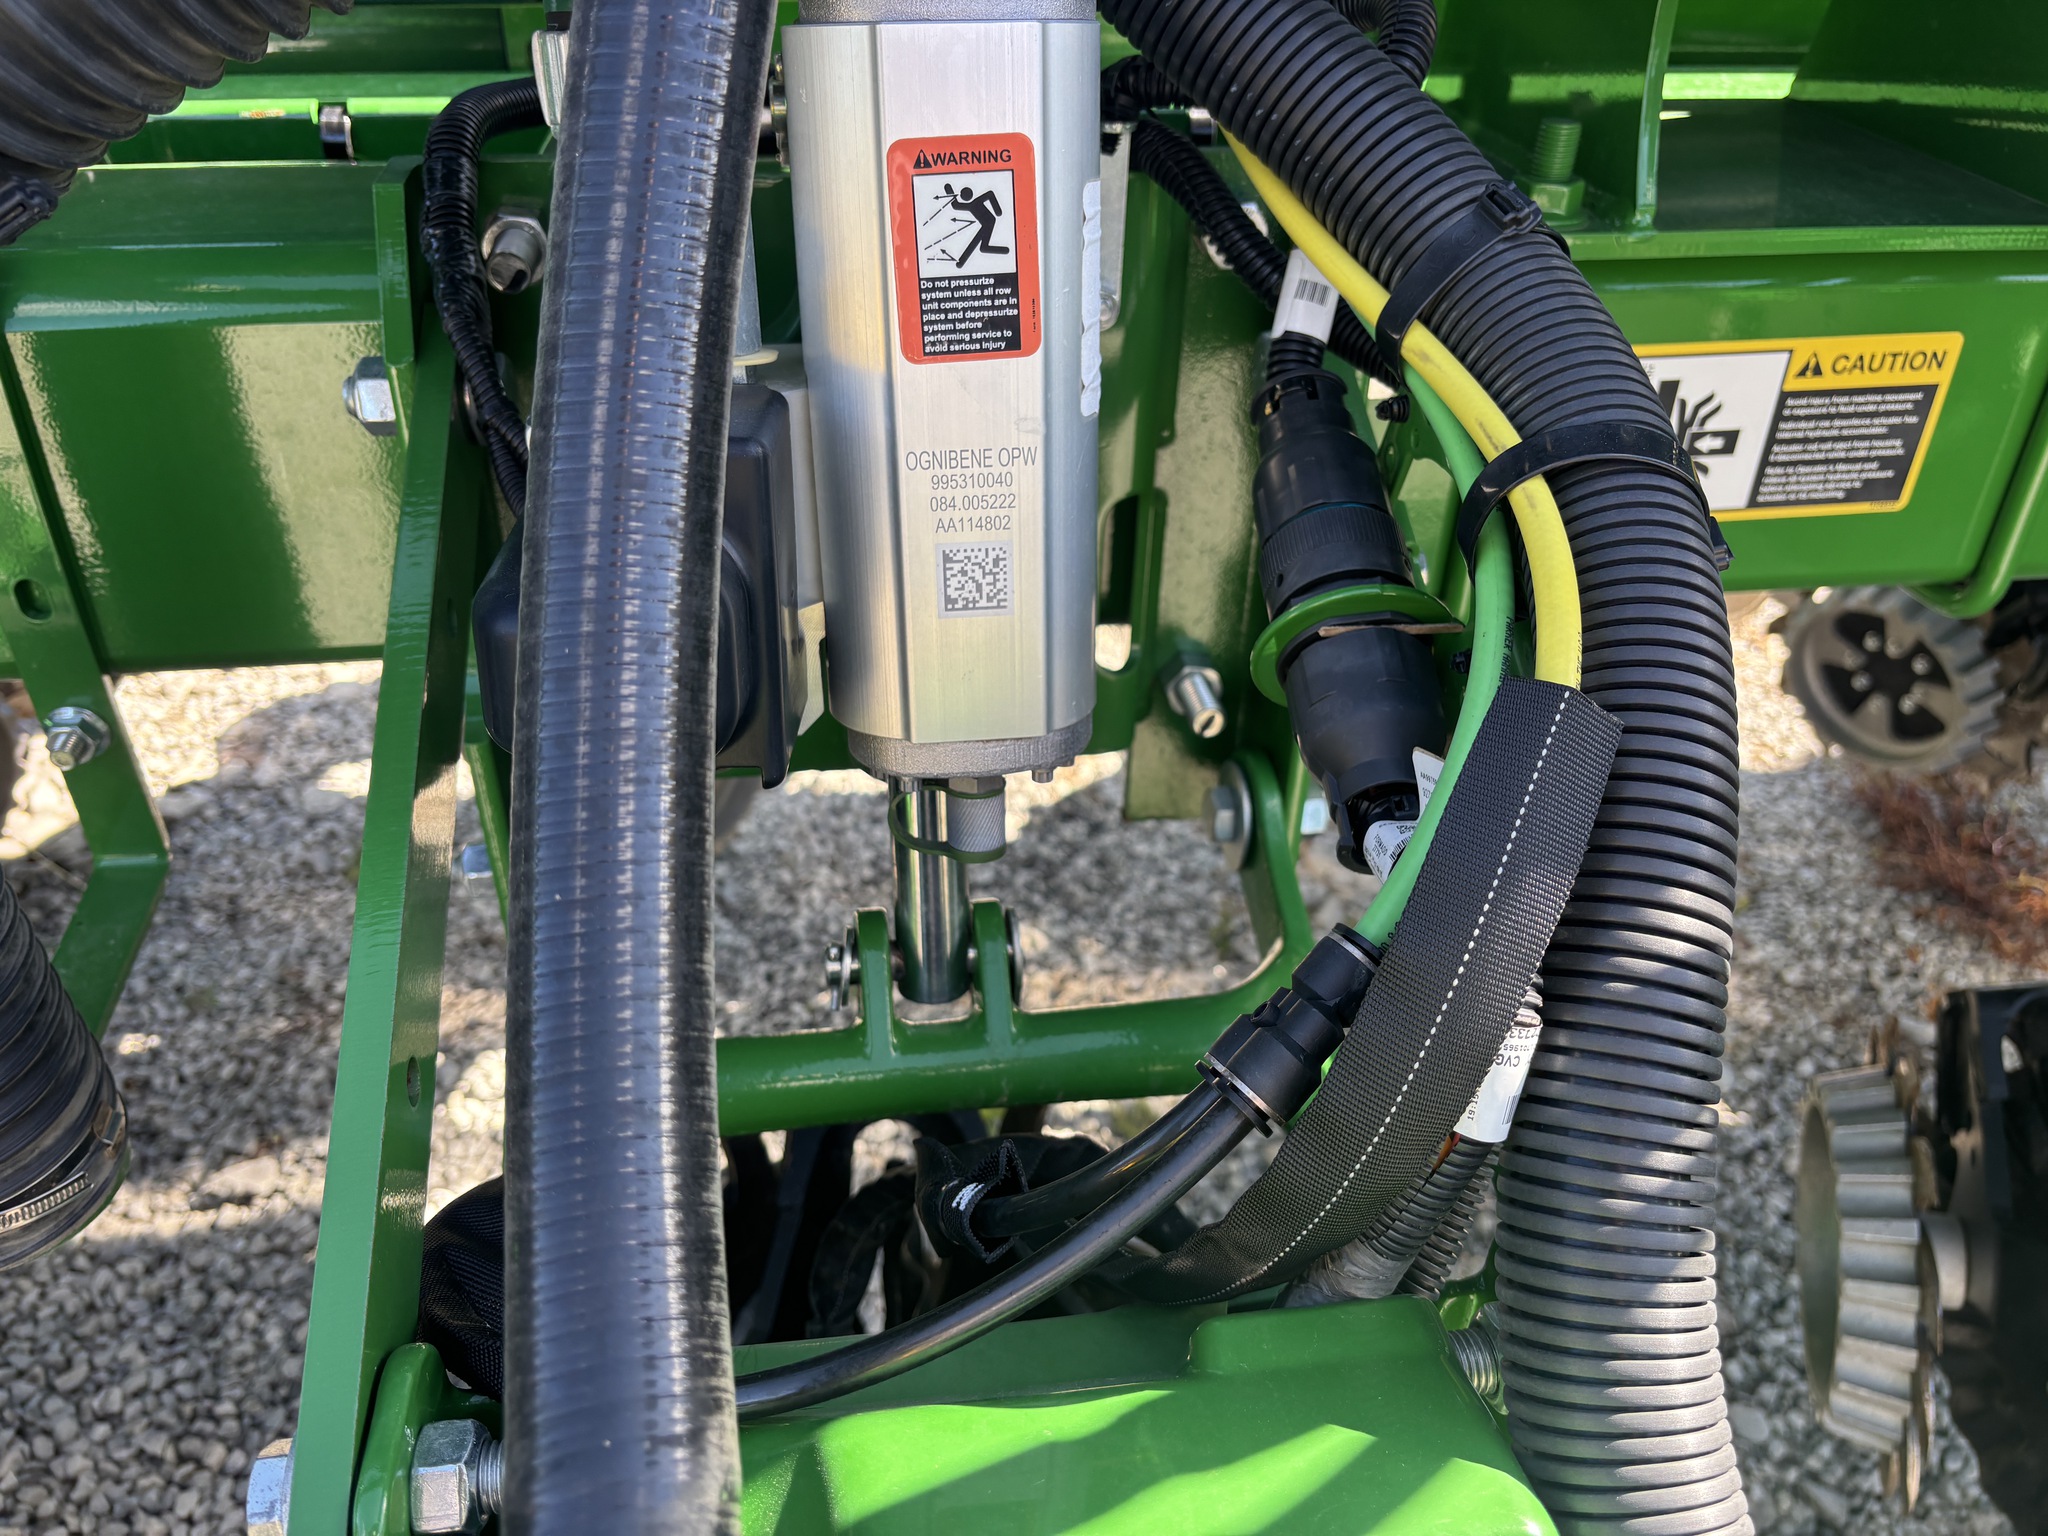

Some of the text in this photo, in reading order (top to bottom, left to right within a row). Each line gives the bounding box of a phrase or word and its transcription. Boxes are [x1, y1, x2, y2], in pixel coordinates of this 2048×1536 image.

[931, 149, 1012, 166] WARNING
[921, 277, 994, 288] Do not pressurize
[921, 291, 952, 300] system
[954, 288, 982, 297] unless
[983, 288, 994, 296] all
[922, 302, 939, 310] unit
[940, 299, 992, 310] components
[1008, 297, 1018, 305] in
[923, 308, 1018, 322] place and depressurize
[924, 321, 982, 332] system before
[924, 330, 1012, 344] performing service to
[925, 340, 1006, 353] avoid serious injury
[1831, 351, 1948, 374] CAUTION
[906, 446, 1037, 471] OGNIBENE OPW
[931, 472, 1013, 490] 995310040
[930, 494, 1016, 512] 084.005222
[936, 515, 1011, 533] AA114802
